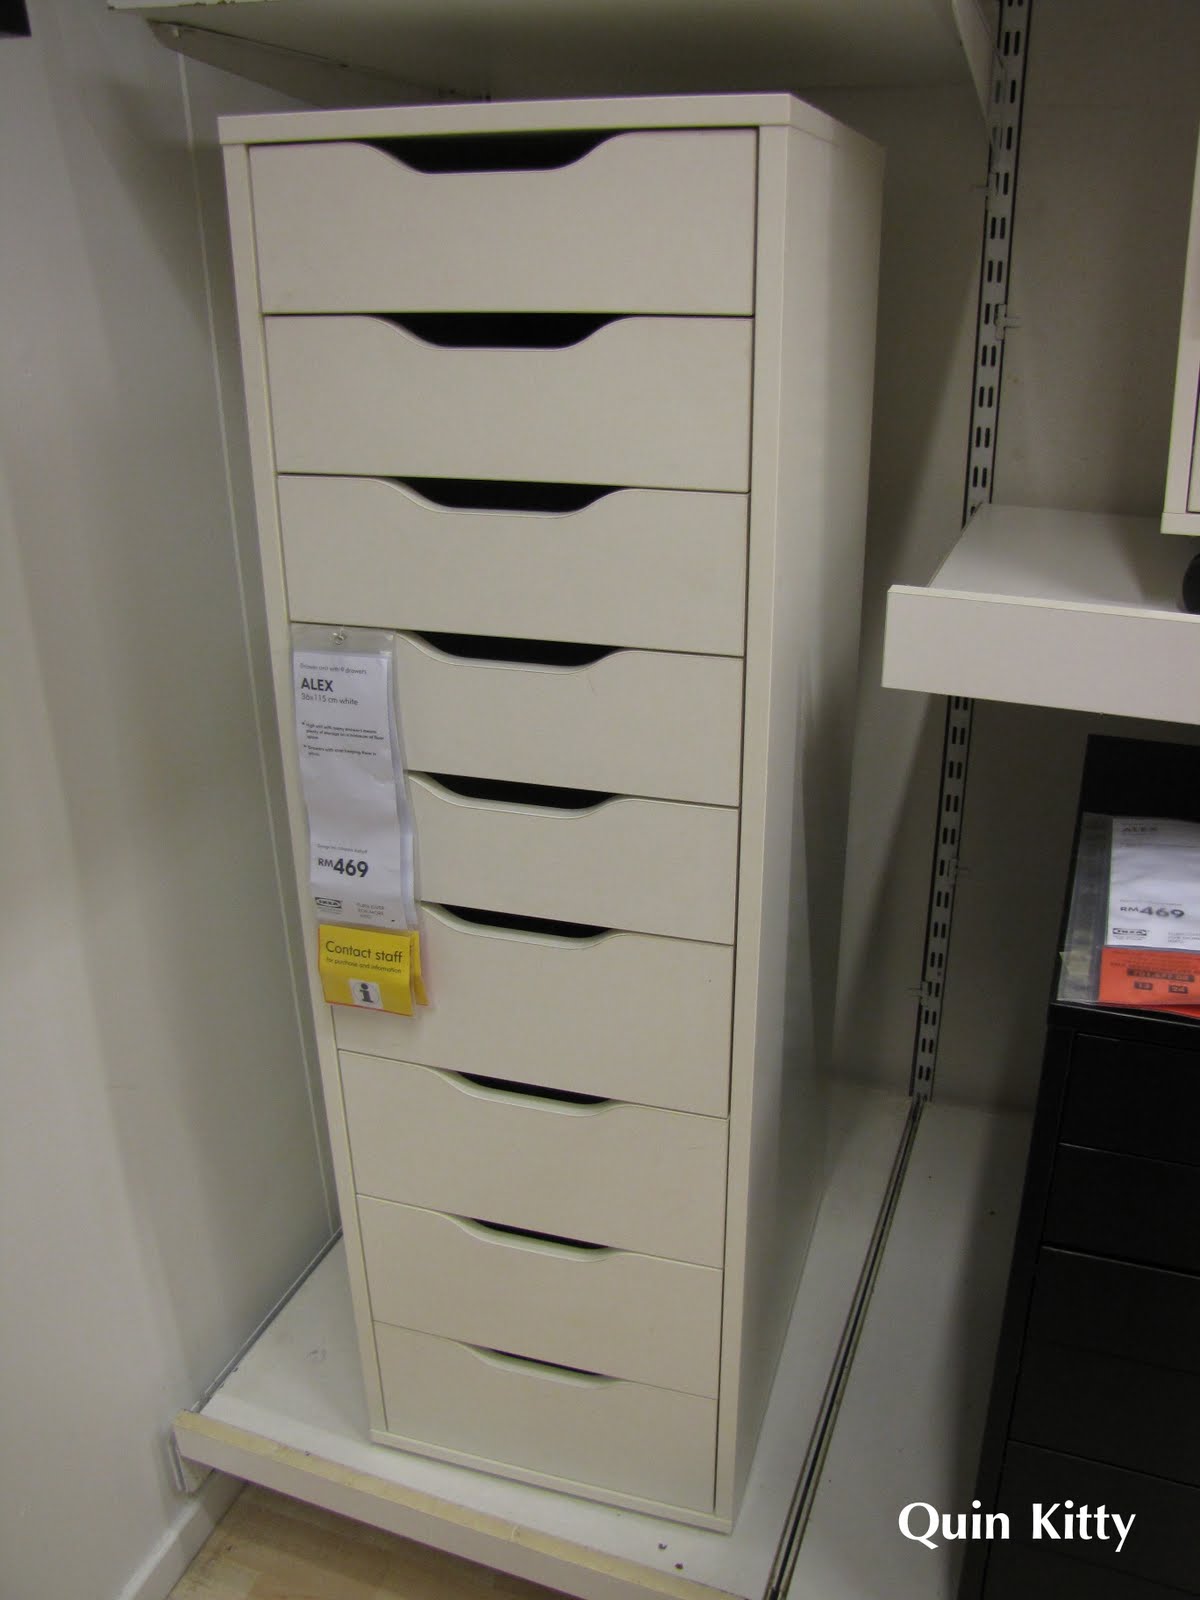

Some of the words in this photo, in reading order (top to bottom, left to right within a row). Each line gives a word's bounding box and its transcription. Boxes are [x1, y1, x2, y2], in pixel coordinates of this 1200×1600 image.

[301, 677, 334, 693] ALEX
[339, 697, 359, 706] white
[325, 940, 372, 959] Contact
[375, 950, 403, 963] staff
[334, 958, 358, 968] purchase
[371, 964, 402, 974] information
